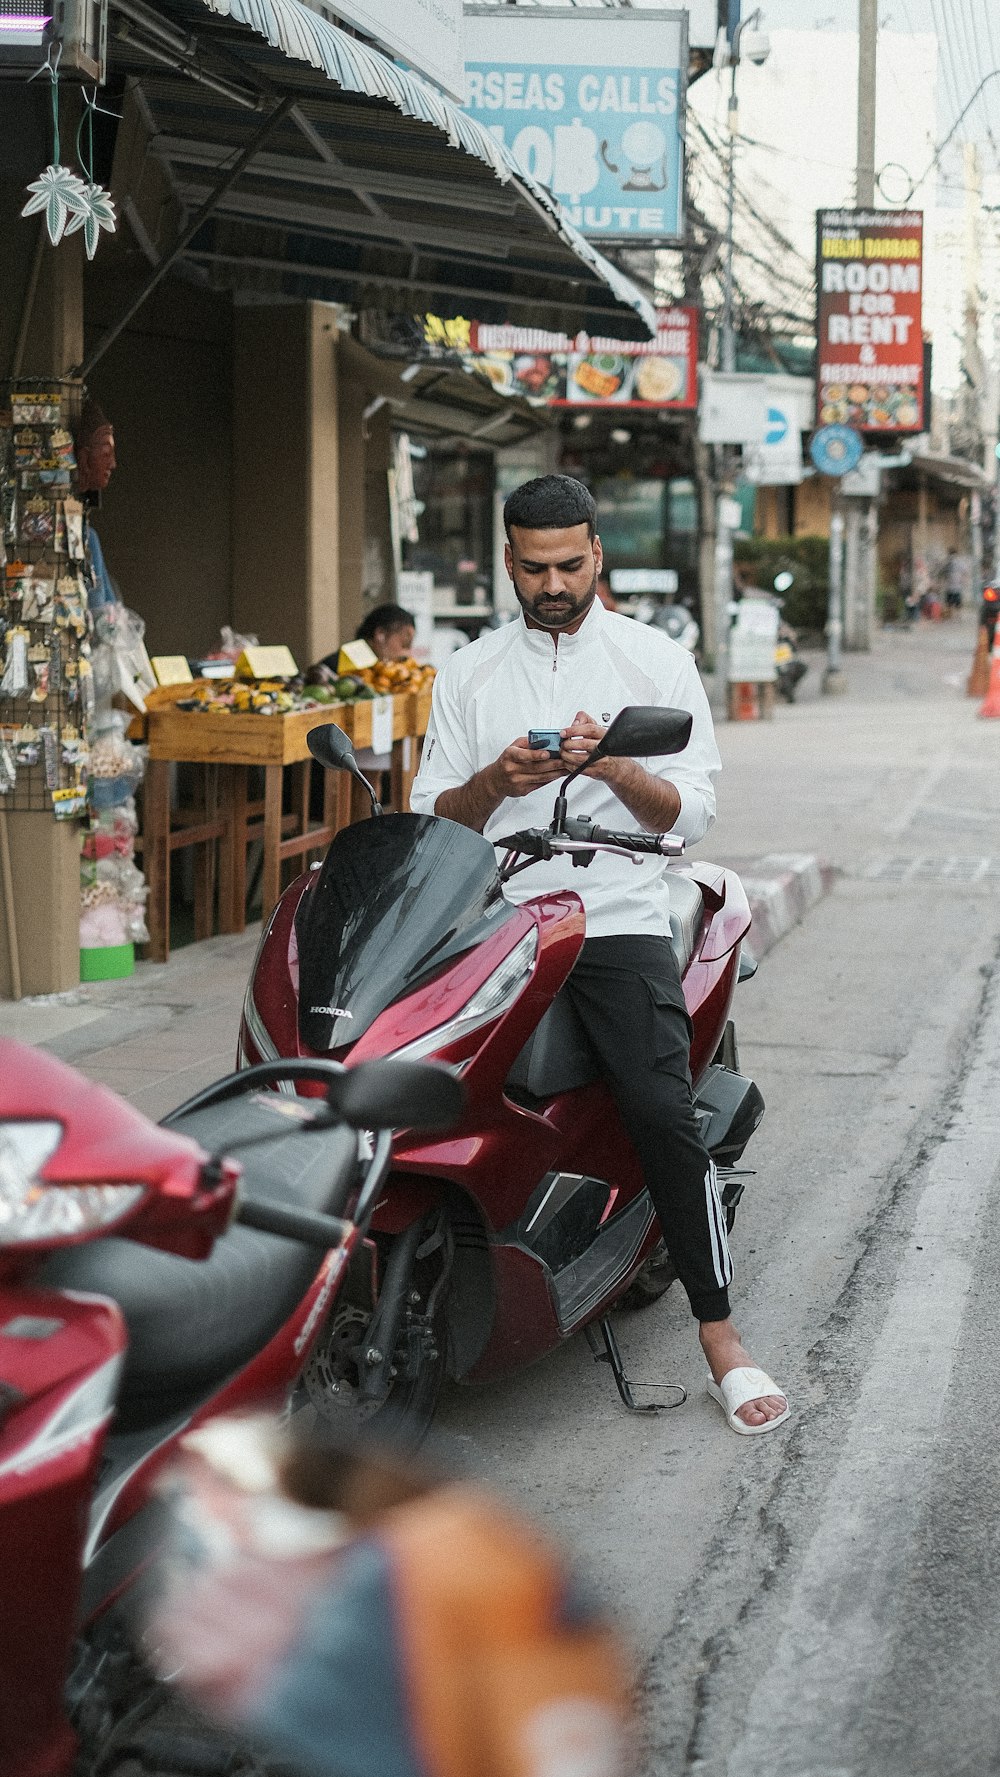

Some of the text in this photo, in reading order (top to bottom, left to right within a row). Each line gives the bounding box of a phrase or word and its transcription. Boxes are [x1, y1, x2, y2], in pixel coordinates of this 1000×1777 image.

[578, 74, 678, 115] CALLS
[822, 263, 919, 293] ROOM
[849, 294, 895, 315] FOR
[828, 314, 914, 345] RENT
[858, 344, 876, 364] &
[819, 364, 921, 384] RESTAURANT
[310, 1006, 353, 1018] HONDA
